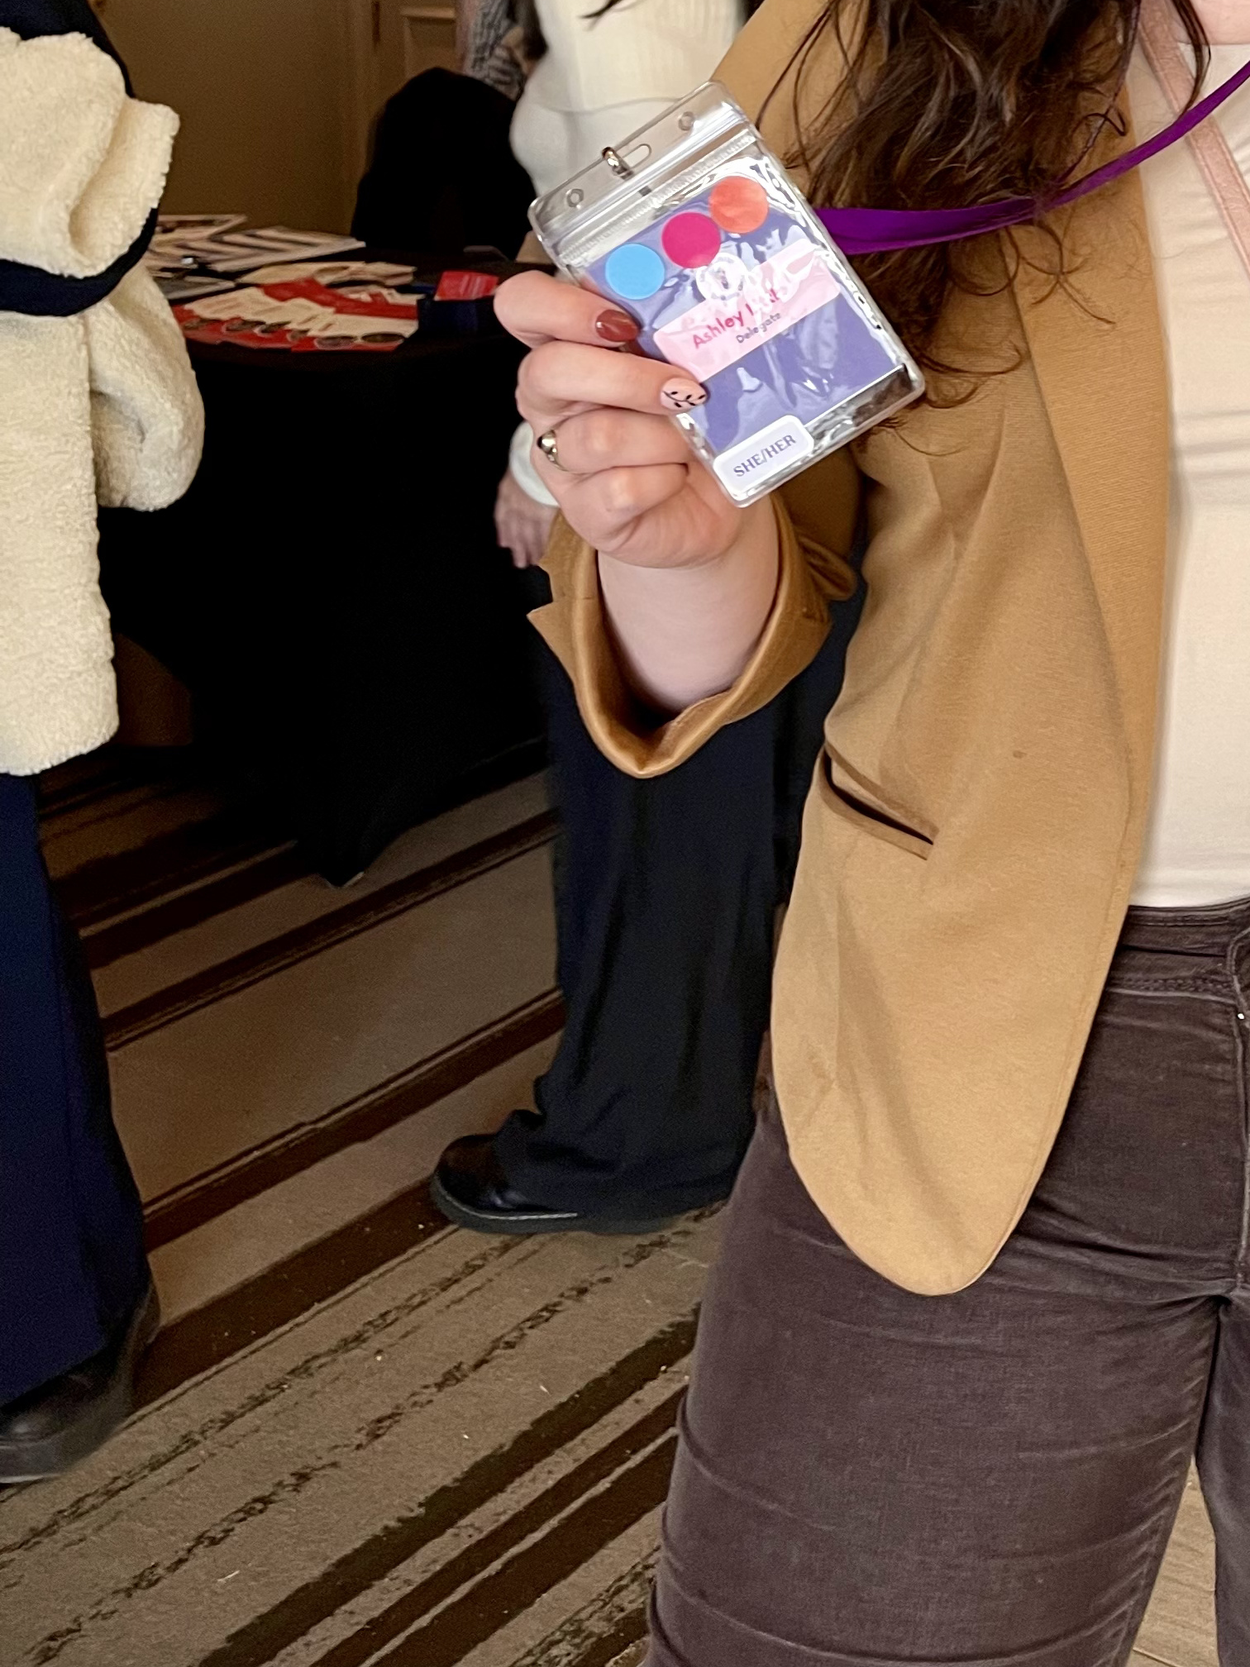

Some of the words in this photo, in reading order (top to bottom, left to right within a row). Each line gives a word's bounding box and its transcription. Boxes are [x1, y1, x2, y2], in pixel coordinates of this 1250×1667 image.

[692, 310, 745, 349] Ashley
[735, 311, 782, 344] Delegate
[733, 434, 797, 477] SHE/HER
